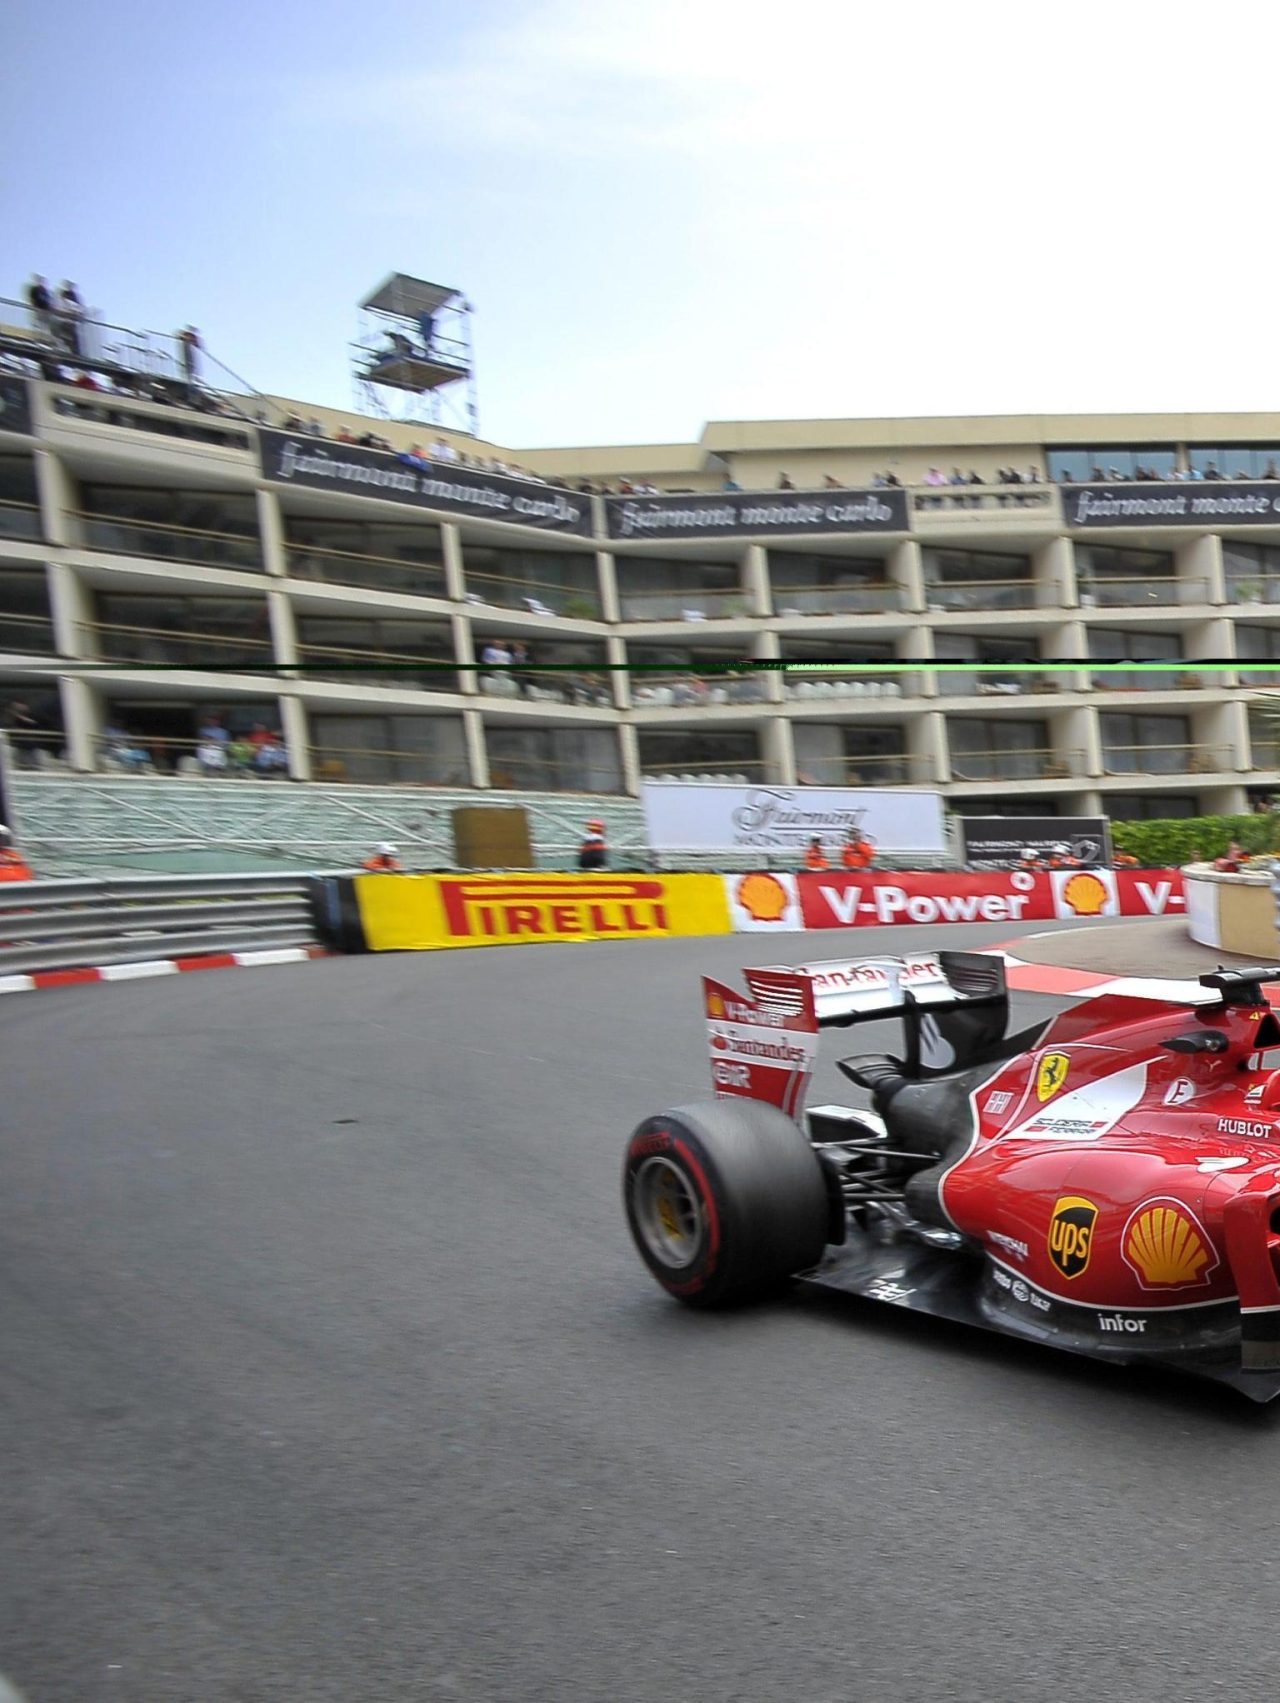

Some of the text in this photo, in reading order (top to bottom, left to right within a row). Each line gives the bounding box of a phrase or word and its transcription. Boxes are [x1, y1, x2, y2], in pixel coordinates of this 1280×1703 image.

[620, 495, 893, 535] fairmont monte carlo
[1074, 490, 1187, 524] fairmont
[1191, 494, 1270, 514] monte
[439, 880, 669, 936] PIRELLI
[818, 885, 1029, 923] V-Power
[1217, 1118, 1272, 1138] HUBLOT
[1051, 1219, 1089, 1266] ups
[1097, 1313, 1147, 1332] infor
